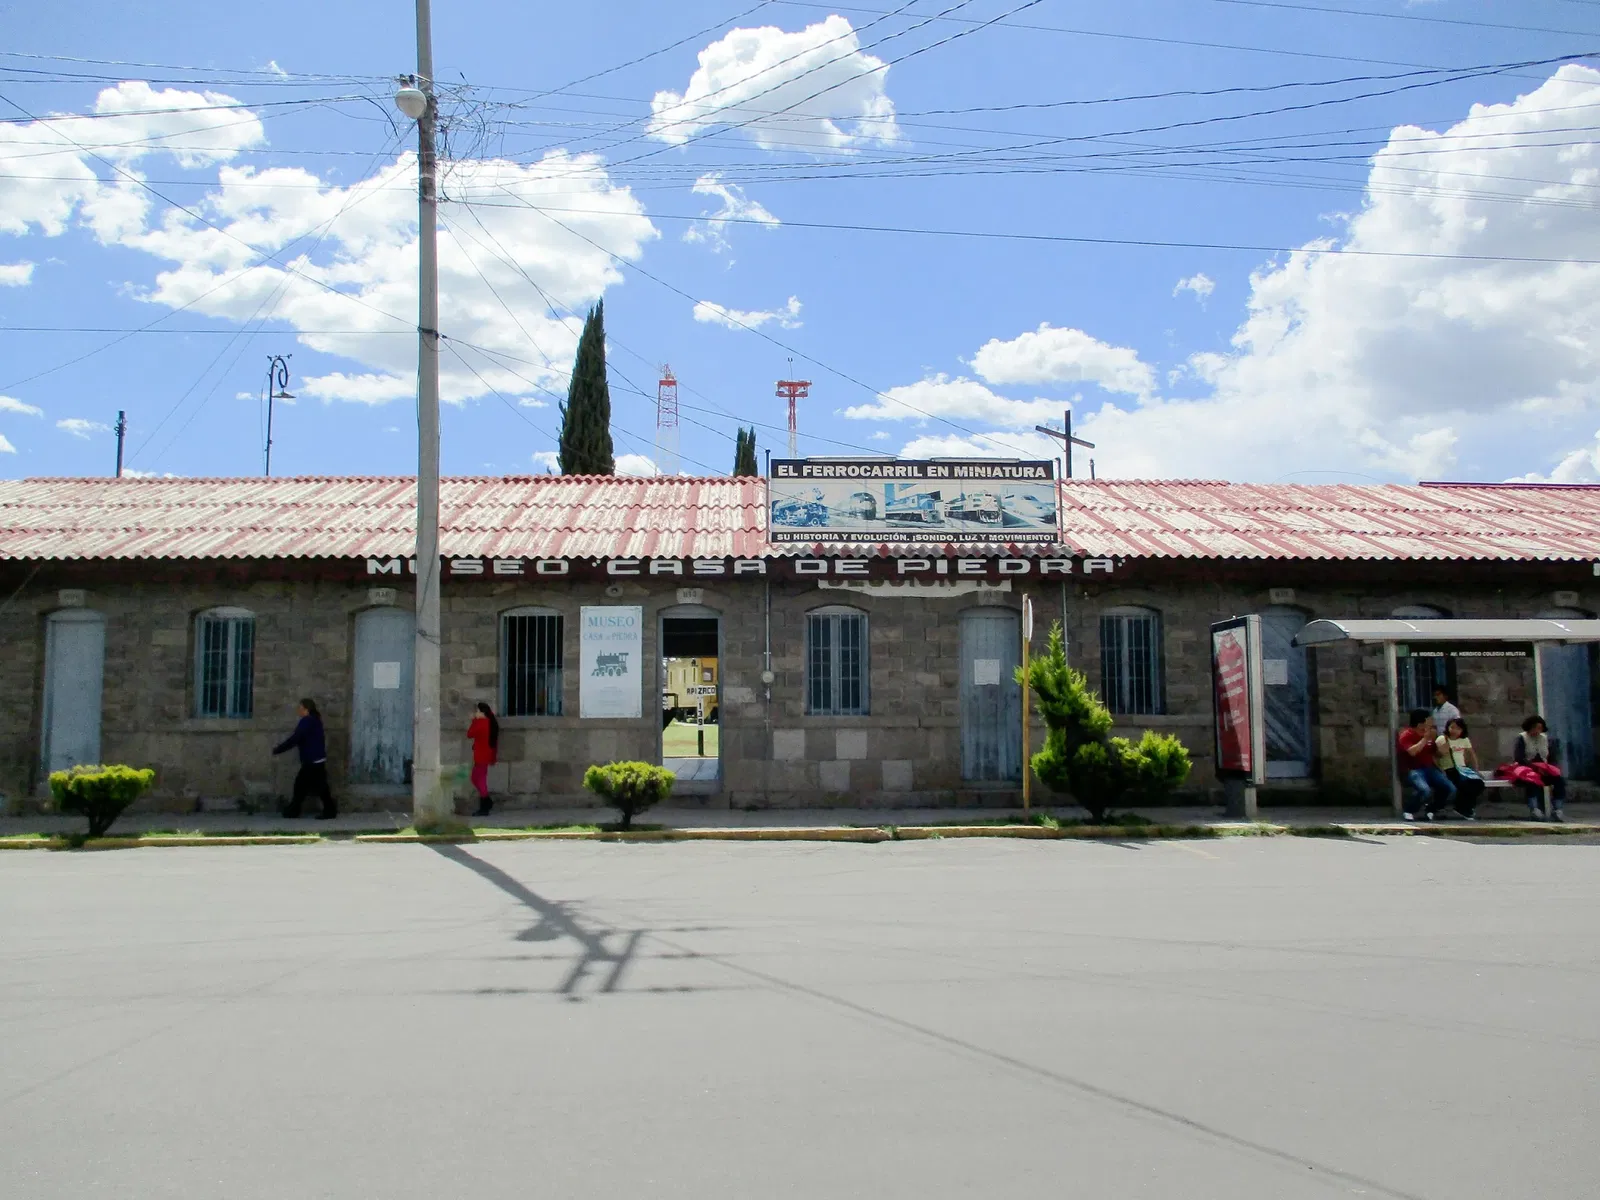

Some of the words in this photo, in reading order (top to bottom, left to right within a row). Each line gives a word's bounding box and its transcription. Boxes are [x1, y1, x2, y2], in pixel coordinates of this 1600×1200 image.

[778, 465, 799, 477] EL
[803, 465, 923, 478] FERROCARRIL
[927, 466, 948, 478] EN
[954, 466, 1047, 478] MINIATURA
[793, 533, 839, 541] HISTORIA
[842, 533, 849, 541] Y
[366, 559, 569, 575] MSEO
[795, 559, 869, 575] DE
[588, 616, 634, 626] MUSEO
